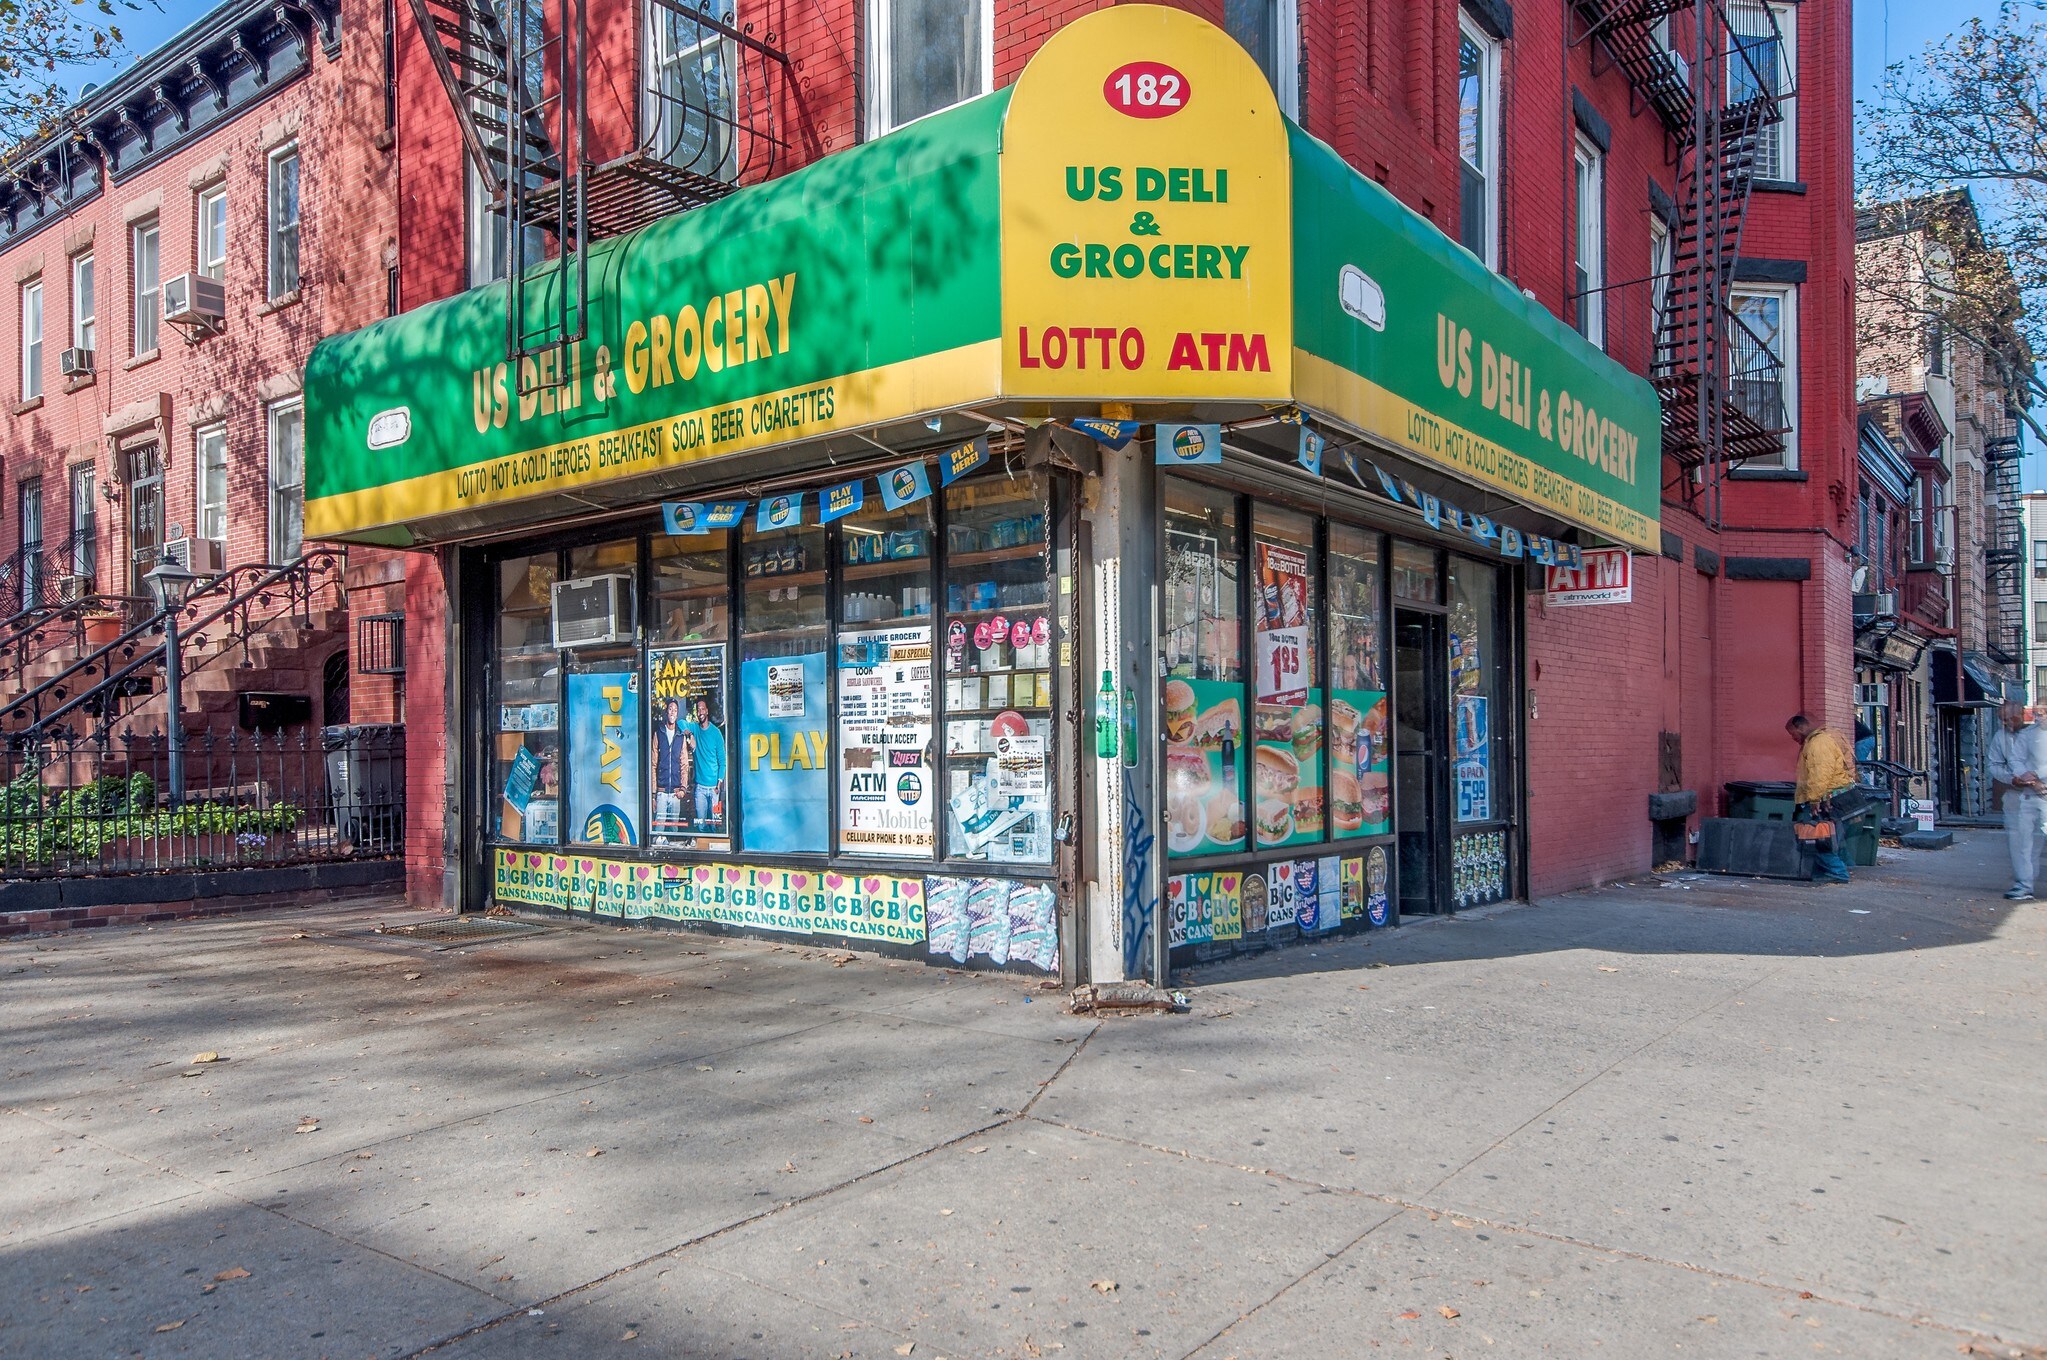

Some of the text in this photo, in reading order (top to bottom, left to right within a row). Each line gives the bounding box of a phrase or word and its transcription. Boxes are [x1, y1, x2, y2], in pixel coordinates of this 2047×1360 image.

[1114, 74, 1181, 107] 182
[1065, 166, 1228, 203] US DELI
[1129, 211, 1162, 236] &
[1050, 243, 1250, 279] GROCERY
[473, 272, 797, 434] US DELI & GROCERY
[1019, 326, 1272, 373] LOTTO ATM
[1437, 312, 1639, 487] US DELI & GROCERY
[457, 386, 835, 499] LOTTO HOT & COLD HEROES BREAKFAST SODA BEER CIGARETTES
[951, 441, 974, 463] PLAY
[951, 451, 979, 476] HERE!
[1407, 408, 1648, 541] LOTTO HOT & COLD HEROES BREAKFAST SODA BEER CIGARETTES
[830, 485, 852, 502] PLAY
[829, 495, 854, 513] HERE!
[1184, 550, 1212, 566] BEER
[1267, 557, 1306, 577] 18oz BOTTLE
[1550, 553, 1623, 591] ATM
[1563, 591, 1611, 601] atmworld
[889, 632, 921, 641] GROCERY
[1281, 634, 1298, 645] BOTTLE
[893, 648, 907, 659] DELI
[655, 659, 660, 678] I
[663, 658, 687, 677] AM
[911, 666, 930, 679] COFFEE
[655, 678, 688, 698] NYC
[600, 686, 624, 794] PLAY
[861, 733, 918, 744] WE GLADLY ACCEPT
[749, 731, 828, 771] PLAY
[893, 751, 920, 766] QUEST
[1467, 766, 1485, 778] PACK
[849, 773, 887, 792] ATM
[846, 832, 924, 845] CELLULAR PHONE $ 10 25
[499, 852, 504, 866] I
[523, 854, 528, 868] I
[548, 856, 553, 871] I
[574, 859, 580, 874] I
[601, 863, 607, 878] I
[628, 866, 635, 881] I
[657, 865, 662, 879] I
[687, 867, 693, 881] I
[718, 867, 724, 884] I
[749, 869, 756, 886] I
[1272, 866, 1278, 884] I
[1344, 863, 1349, 879] I
[782, 873, 788, 890] I
[818, 873, 824, 891] I
[854, 877, 861, 894] I
[892, 880, 898, 898] I
[1190, 878, 1197, 897] I
[1216, 876, 1222, 894] I
[497, 887, 520, 898] CANS
[520, 889, 544, 902] CANS
[544, 892, 569, 906] CANS
[570, 896, 591, 908] CAN
[597, 901, 624, 914] CANS
[653, 902, 681, 917] CANS
[626, 905, 653, 917] CANS
[682, 905, 712, 920] CANS
[713, 907, 744, 921] CANS
[744, 910, 777, 926] CANS
[1270, 907, 1294, 922] CANS
[778, 915, 811, 930] CANS
[813, 916, 848, 931] CANS
[850, 921, 885, 936] CANS
[1214, 922, 1240, 936] CANS
[886, 925, 924, 940] CANS
[1187, 924, 1213, 940] CANS
